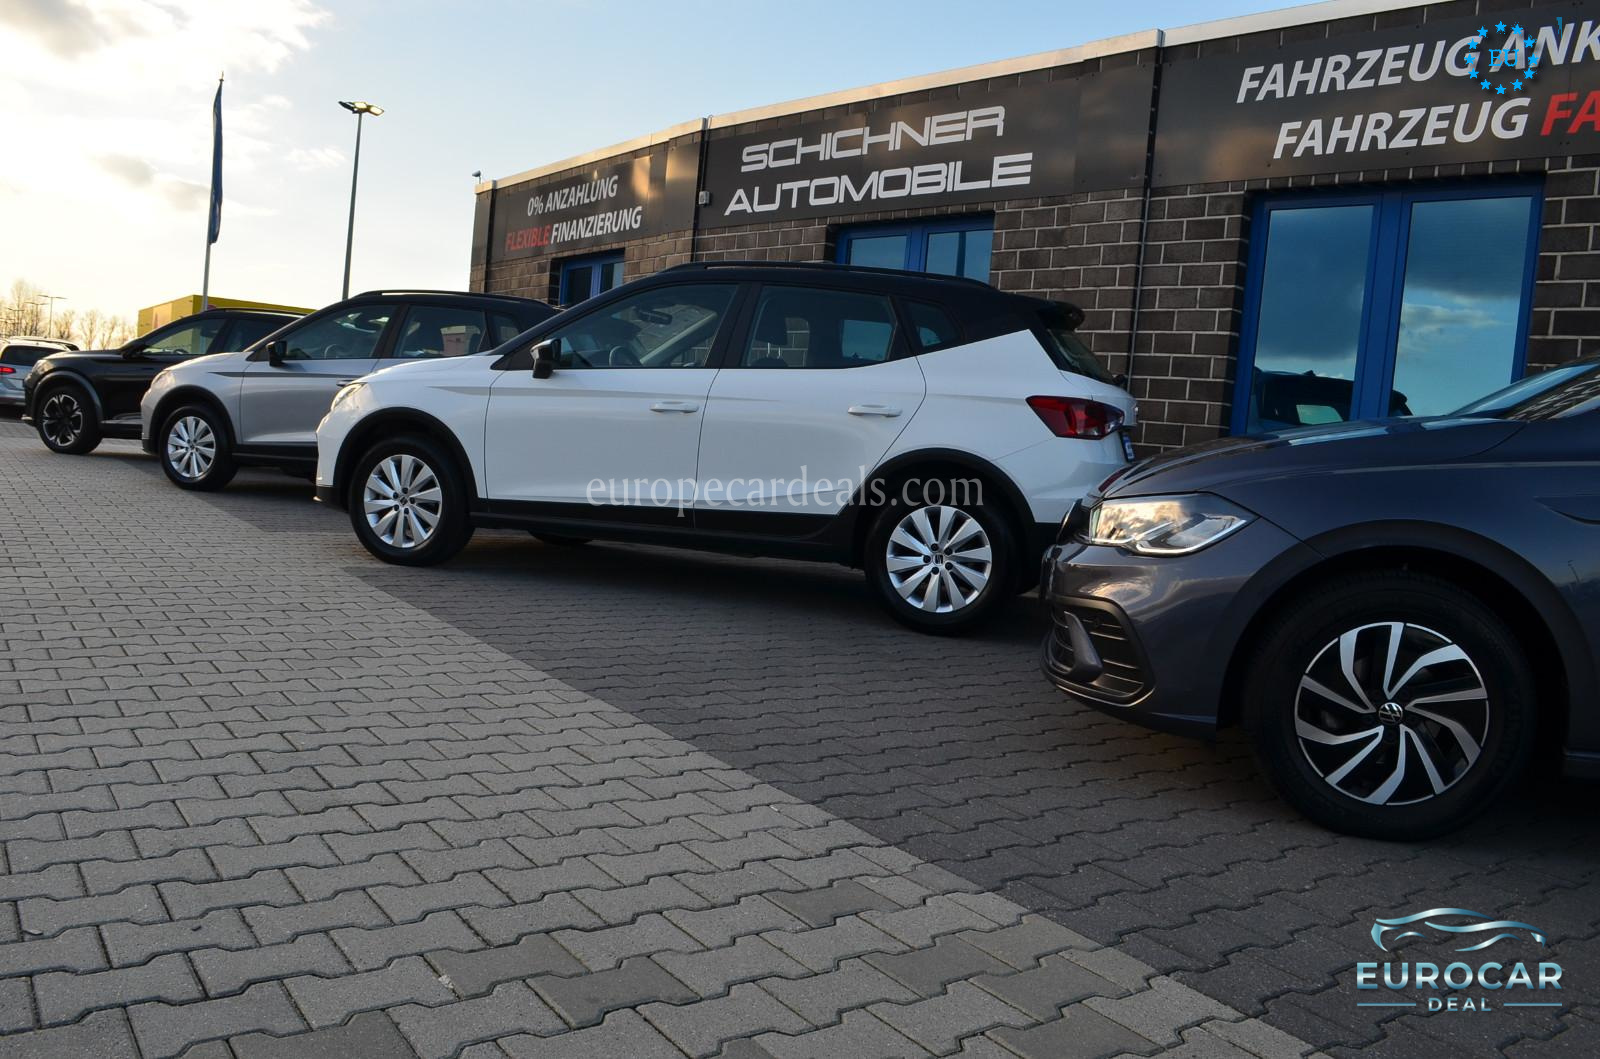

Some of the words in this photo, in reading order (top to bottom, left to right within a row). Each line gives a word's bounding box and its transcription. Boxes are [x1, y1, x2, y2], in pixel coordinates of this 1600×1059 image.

[1236, 35, 1484, 104] FAHRZEUG
[740, 105, 1006, 173] SCHICHNER
[1273, 97, 1532, 160] FAHRZEUG
[527, 195, 544, 217] 0%
[544, 175, 619, 214] ANZAHLUNG
[724, 152, 1034, 216] AUTOMOBILE
[505, 224, 551, 251] FLEXIBLE
[550, 206, 643, 245] FINANZIERUNG
